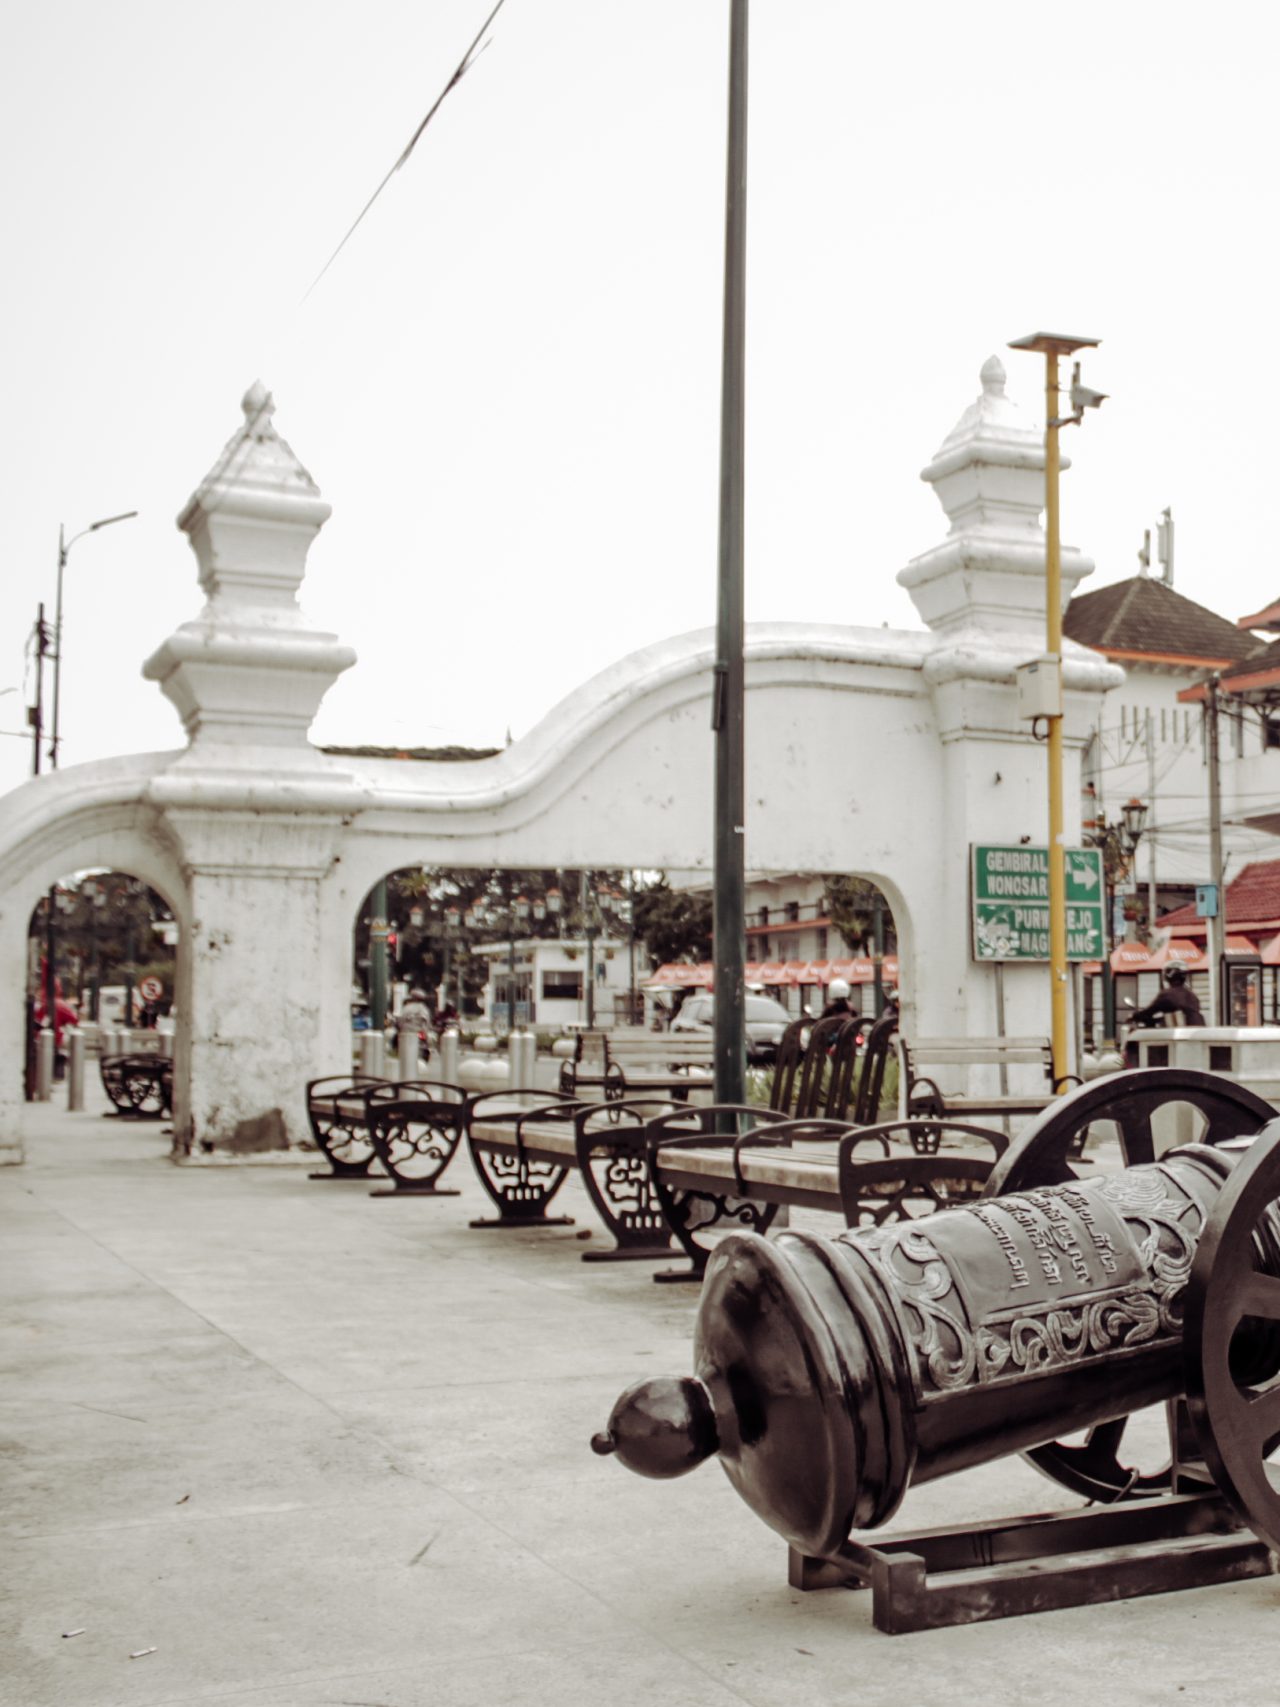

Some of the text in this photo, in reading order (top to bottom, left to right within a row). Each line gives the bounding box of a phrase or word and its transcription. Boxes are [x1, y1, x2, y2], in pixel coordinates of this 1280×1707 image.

[986, 851, 1073, 874] GEMBIRALA
[986, 873, 1050, 897] WONOSAR
[1014, 908, 1093, 930] PURWEJO
[1020, 931, 1096, 954] MAGANG
